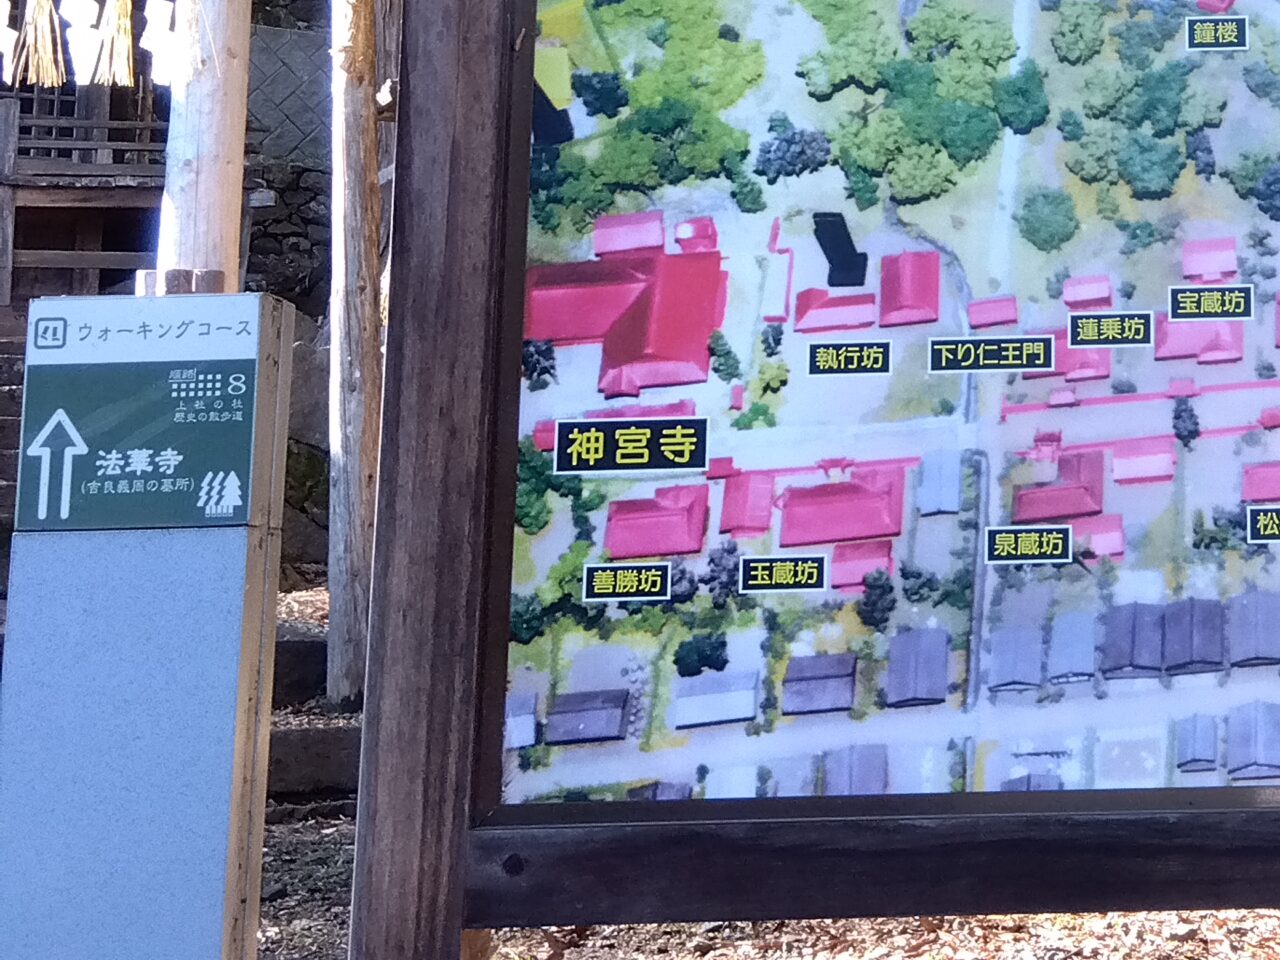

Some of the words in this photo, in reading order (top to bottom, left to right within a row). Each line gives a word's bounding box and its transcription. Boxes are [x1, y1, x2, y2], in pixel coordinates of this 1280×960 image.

[1193, 21, 1240, 45] 鐘楼
[1176, 291, 1246, 314] 宝蔵坊
[78, 319, 252, 342] ウォーキングコース
[1076, 318, 1146, 341] 蓮乗坊
[815, 347, 884, 370] 執行坊
[933, 342, 1046, 367] 下り仁王門
[227, 373, 247, 395] 8
[566, 426, 698, 465] 神宮寺
[95, 447, 184, 476] 法華寺
[994, 532, 1064, 556] 泉蔵坊
[591, 569, 663, 594] 善勝坊
[747, 562, 820, 586] 玉蔵坊
